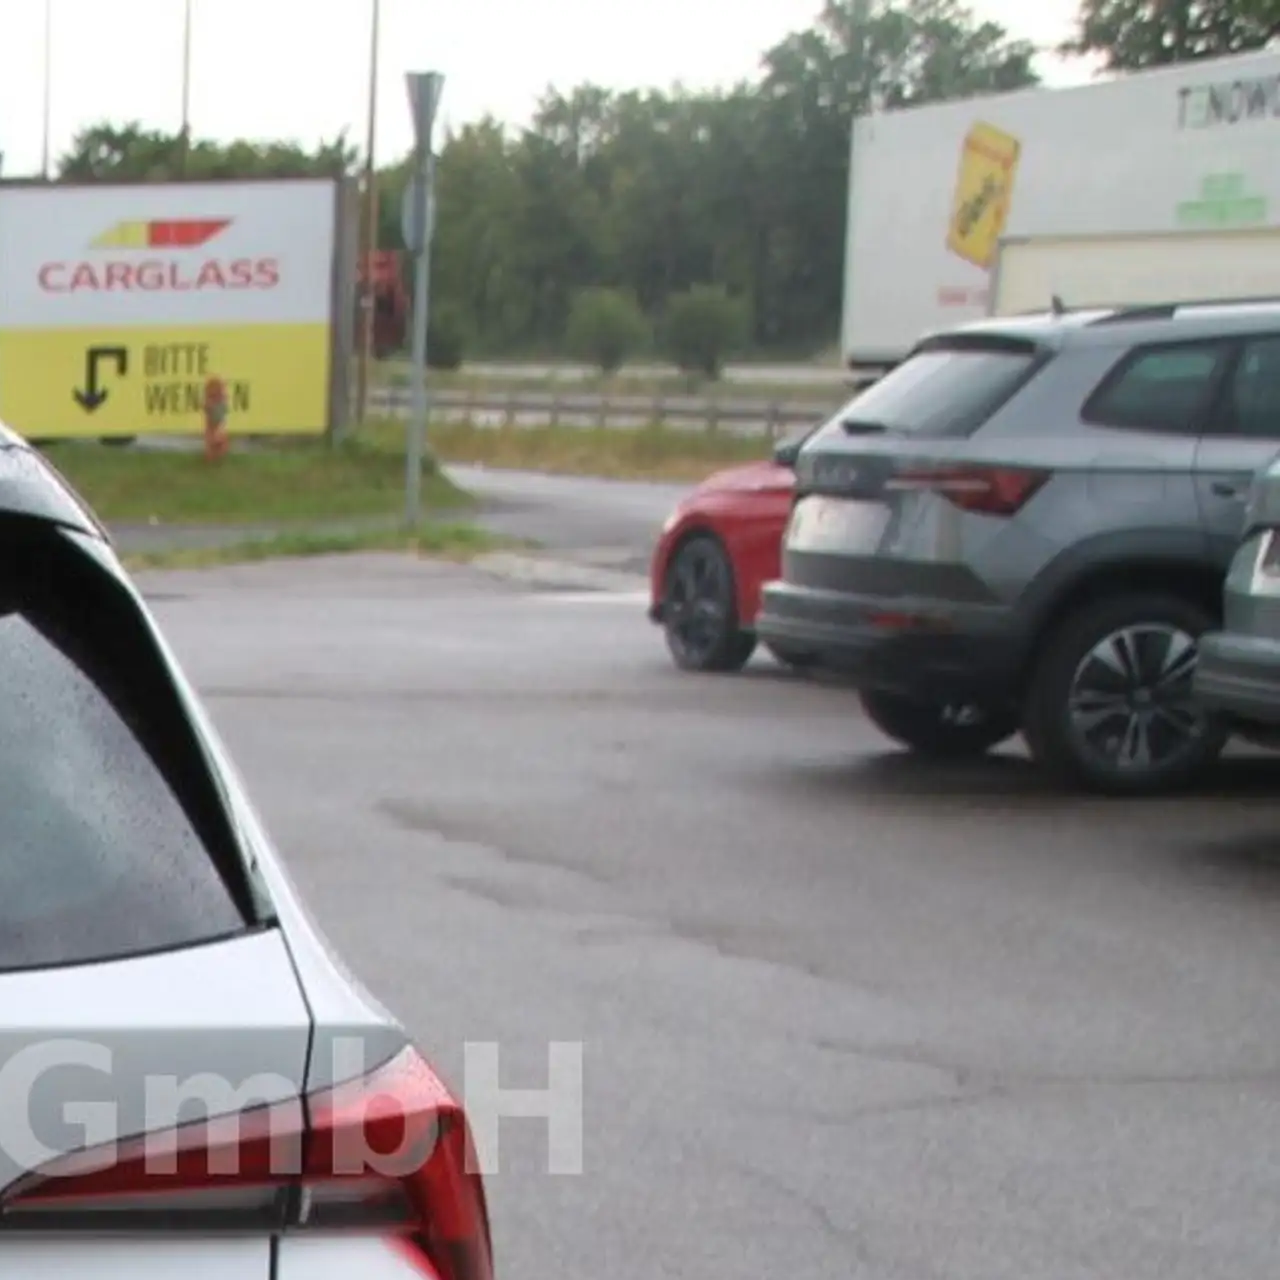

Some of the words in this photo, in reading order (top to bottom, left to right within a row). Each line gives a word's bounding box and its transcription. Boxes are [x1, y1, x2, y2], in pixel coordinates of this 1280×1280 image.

[37, 256, 281, 293] CARGLASS
[143, 342, 209, 378] BITTE
[143, 380, 250, 415] WENN
